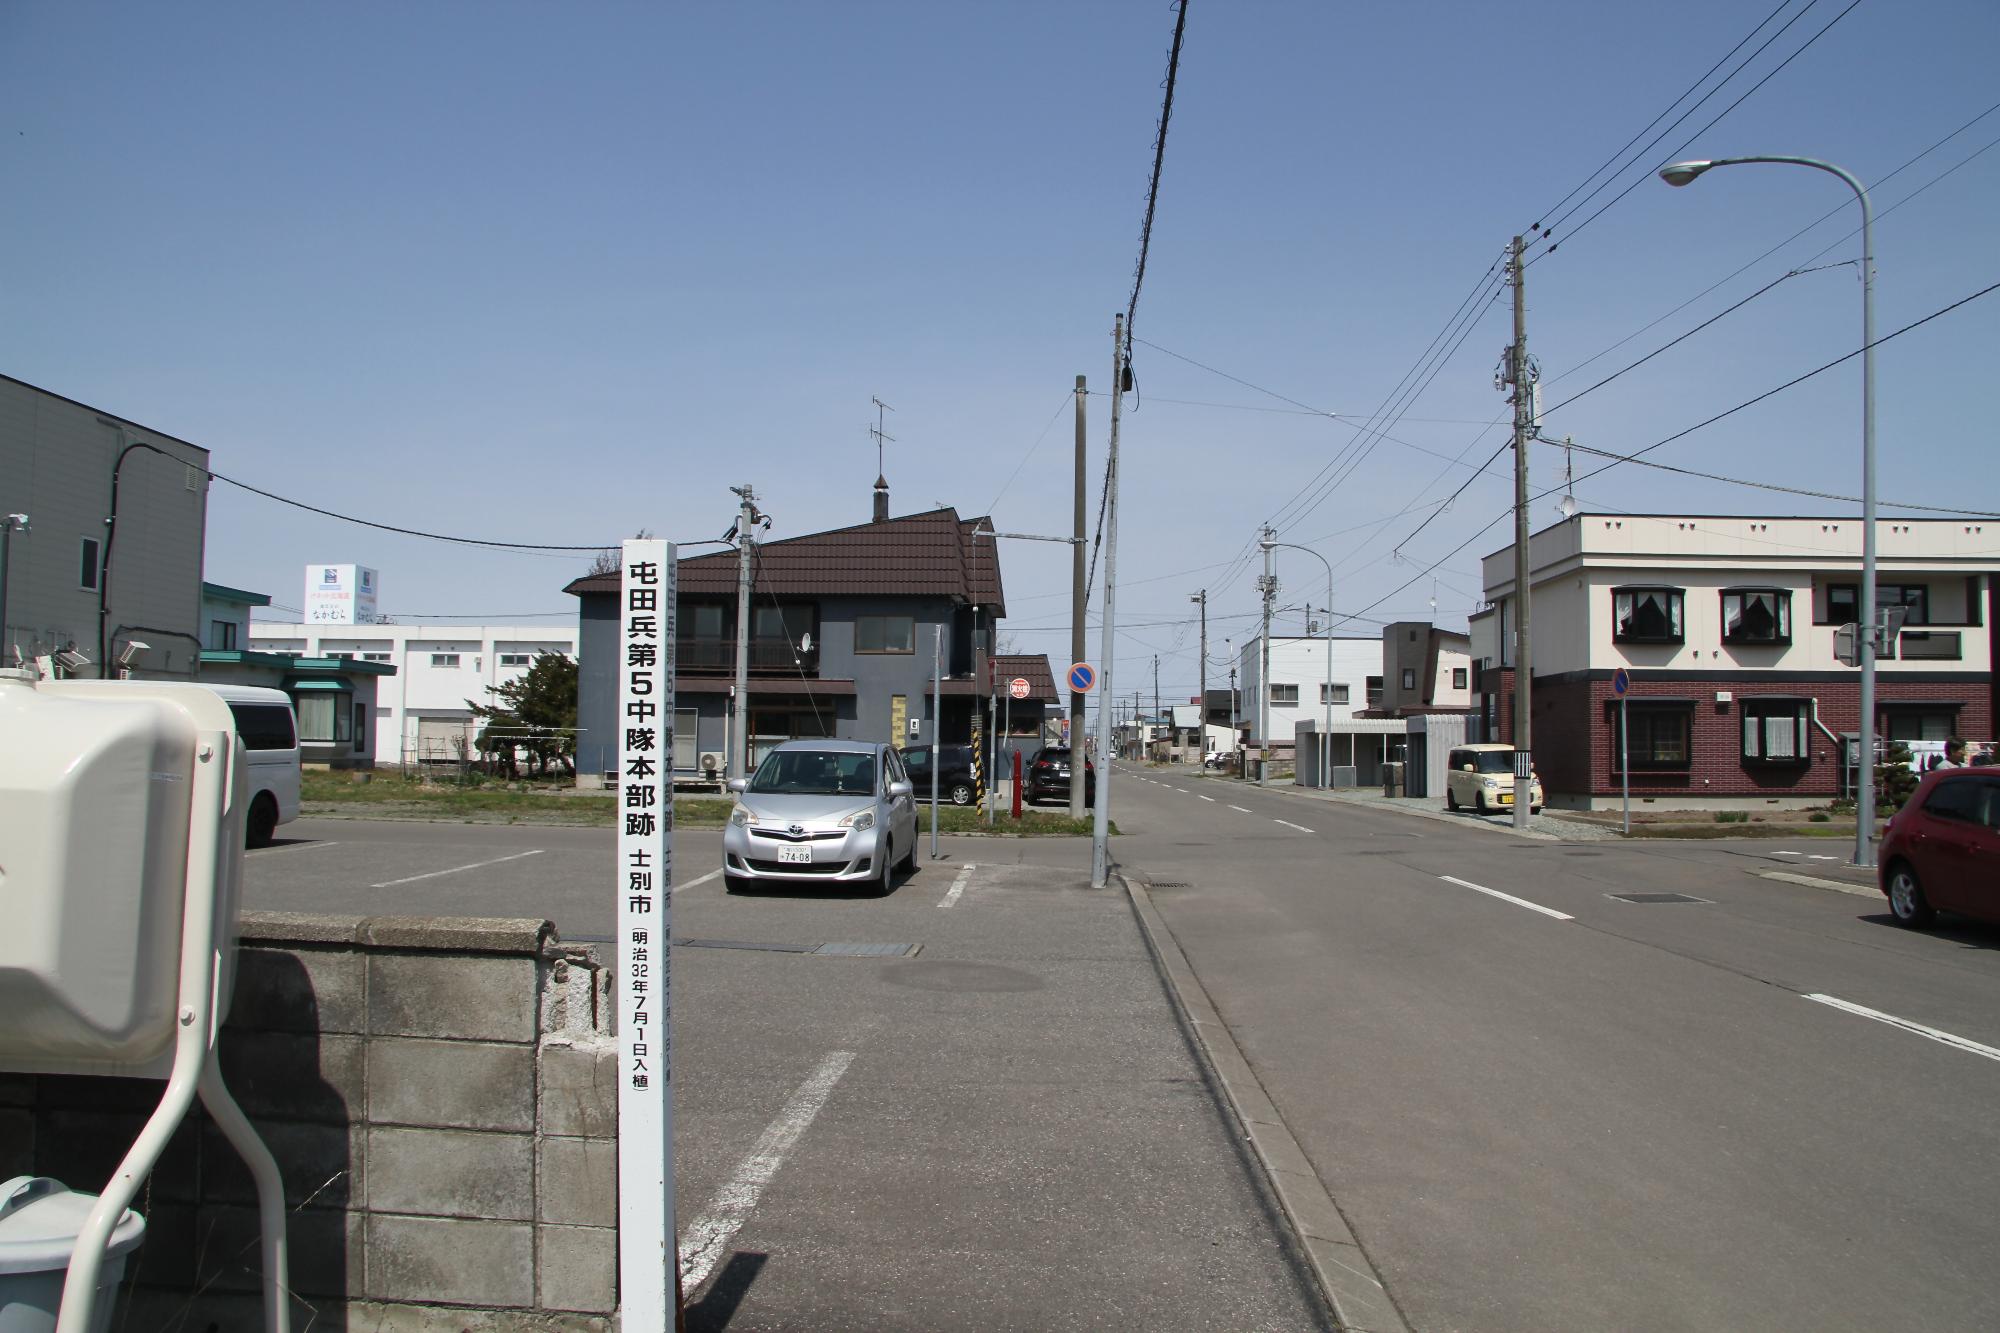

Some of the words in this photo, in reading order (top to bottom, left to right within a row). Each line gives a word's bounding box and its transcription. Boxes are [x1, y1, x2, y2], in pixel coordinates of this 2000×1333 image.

[626, 561, 658, 836] 屯田兵第5中隊本部跡
[629, 848, 652, 914] 士別市
[785, 852, 810, 862] 74-08
